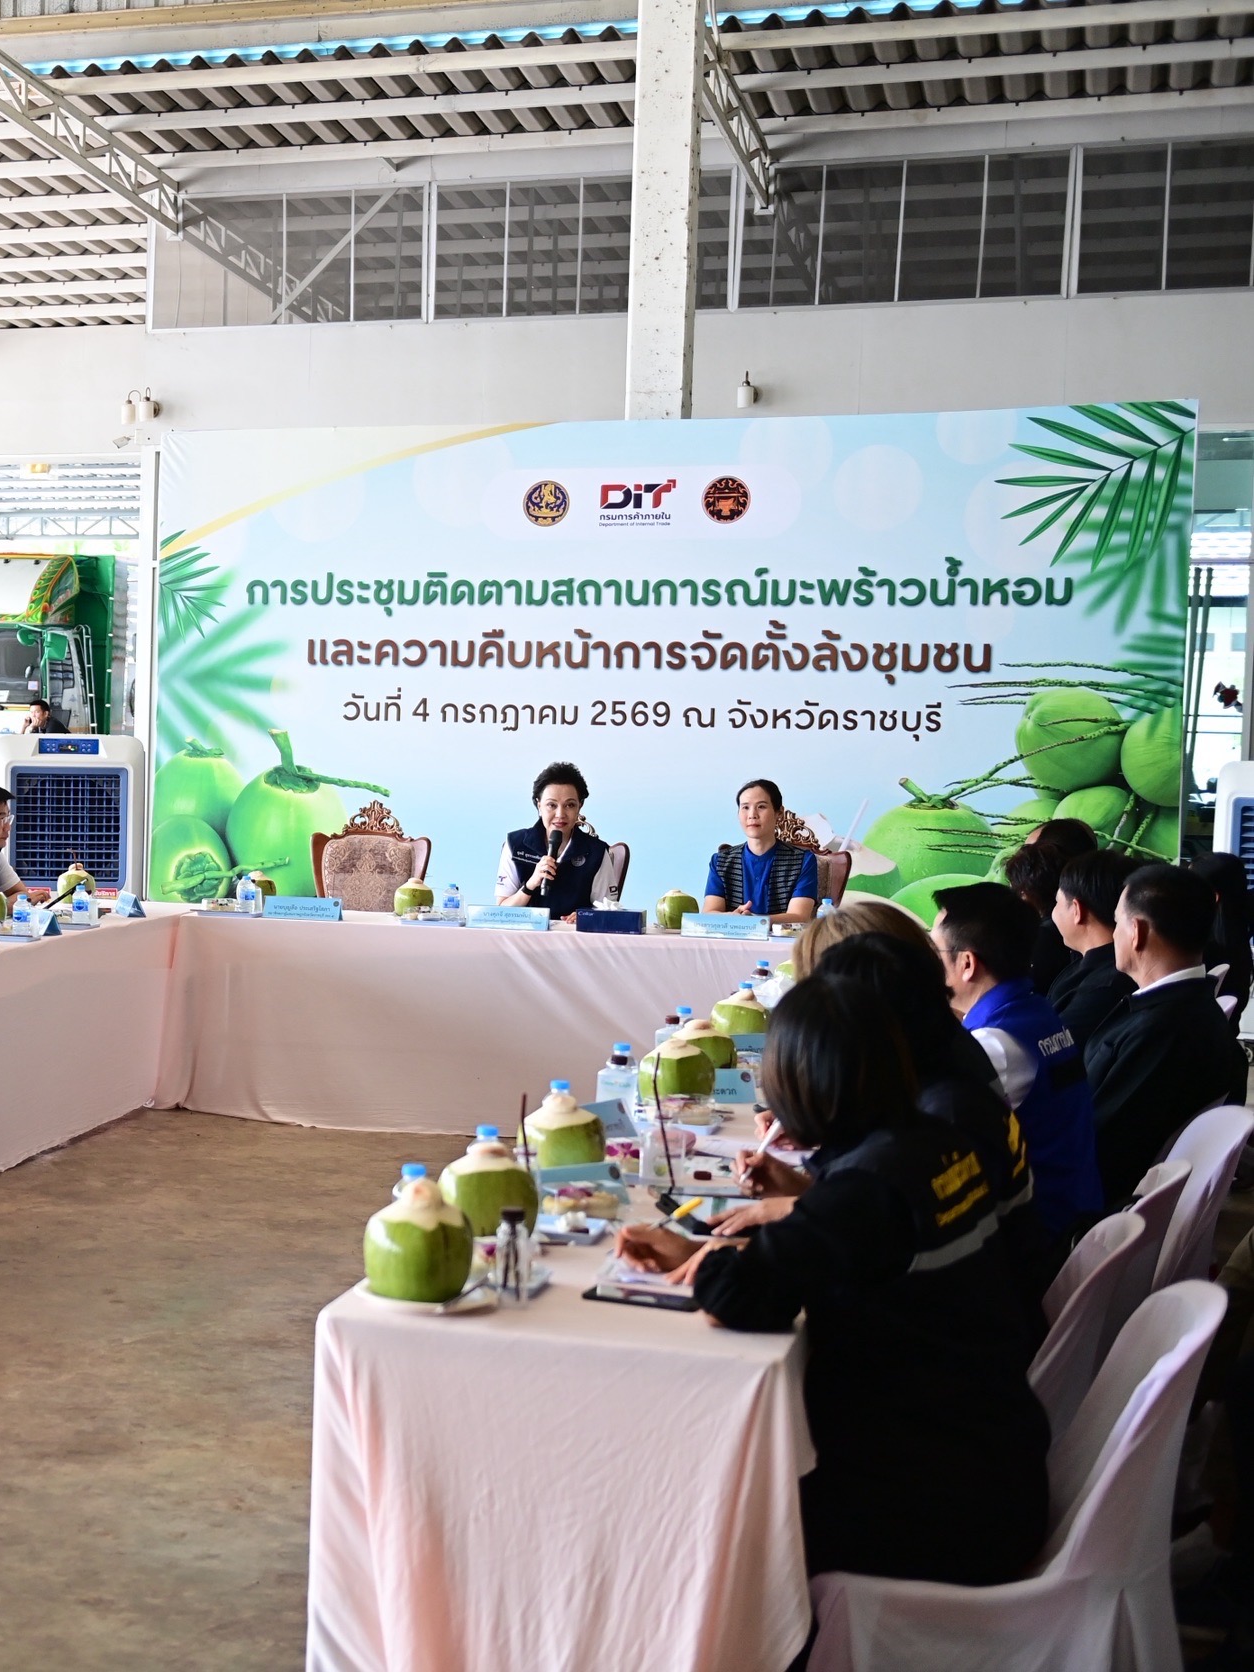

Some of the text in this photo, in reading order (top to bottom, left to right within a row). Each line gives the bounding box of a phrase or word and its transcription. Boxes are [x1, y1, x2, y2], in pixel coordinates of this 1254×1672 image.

[599, 511, 671, 521] กรมการค้าภายใน
[246, 556, 1074, 617] การประชุมติดตามสถานการณ์มะพร้าวน้ำหอม
[307, 620, 992, 684] และความคืบหน้าการจัดตั้งล้งชุมชน
[343, 687, 943, 742] วันที่ 4 กรกฎาคม 2569 ณ จังหวัดราชบุรี
